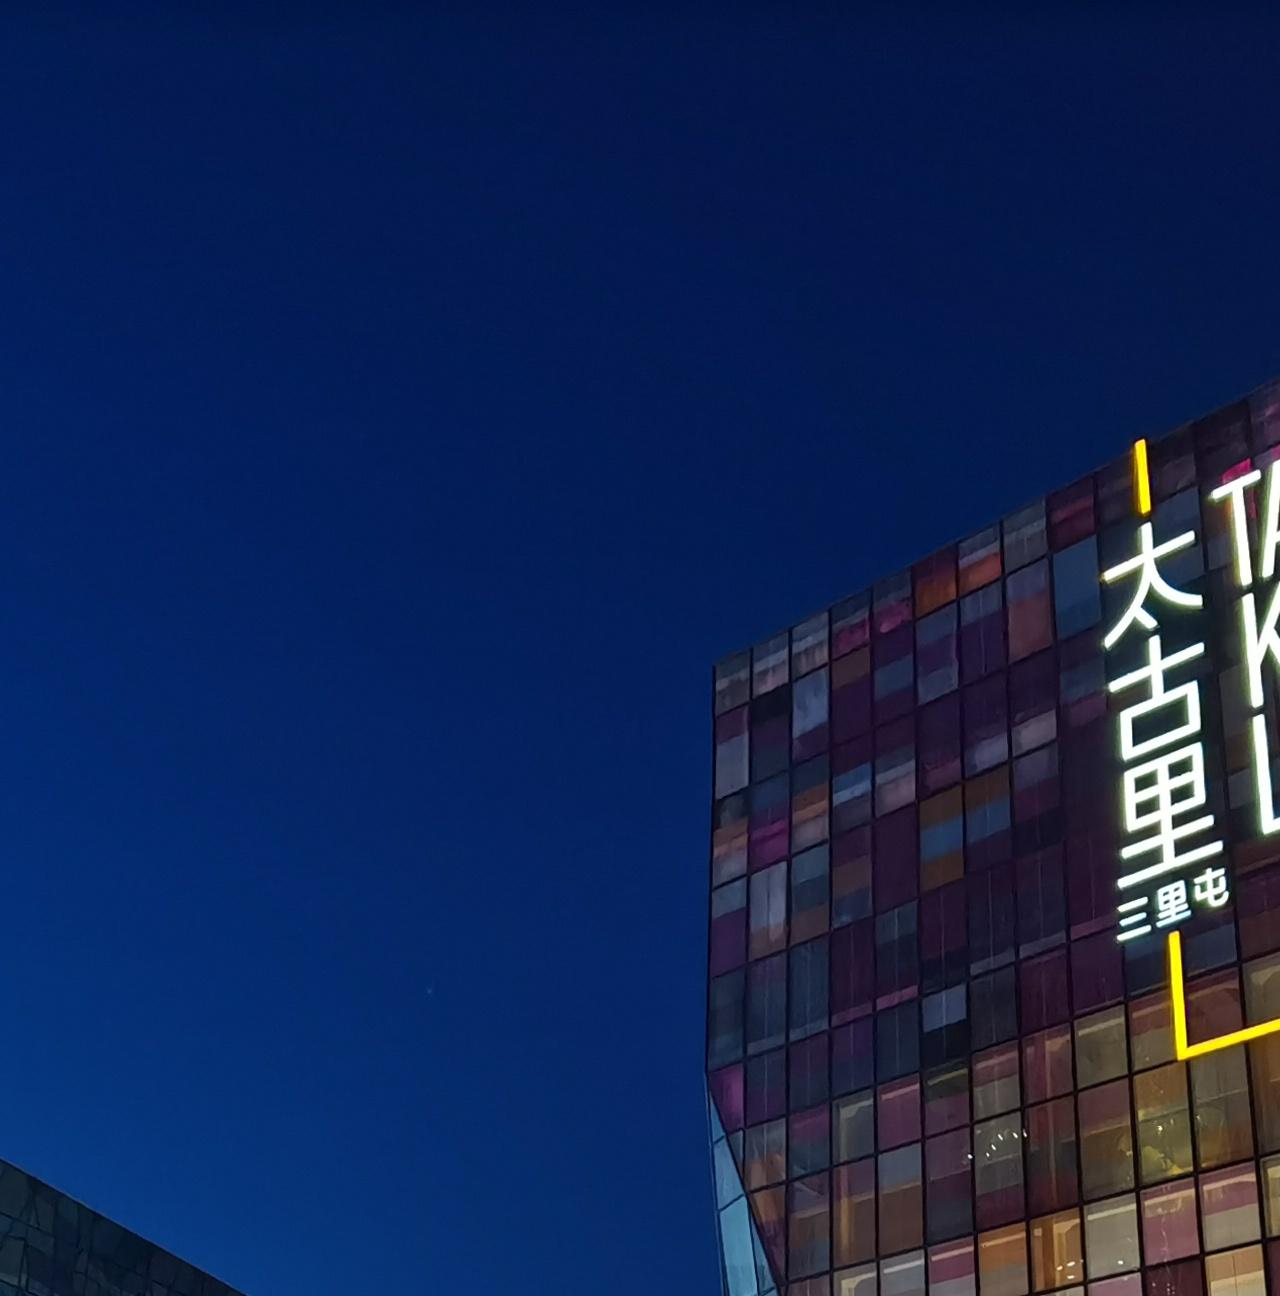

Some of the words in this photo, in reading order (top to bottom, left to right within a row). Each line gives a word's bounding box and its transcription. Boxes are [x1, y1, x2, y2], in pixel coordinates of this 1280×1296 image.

[1100, 521, 1224, 889] 太古里
[1116, 868, 1231, 943] 三里屯
